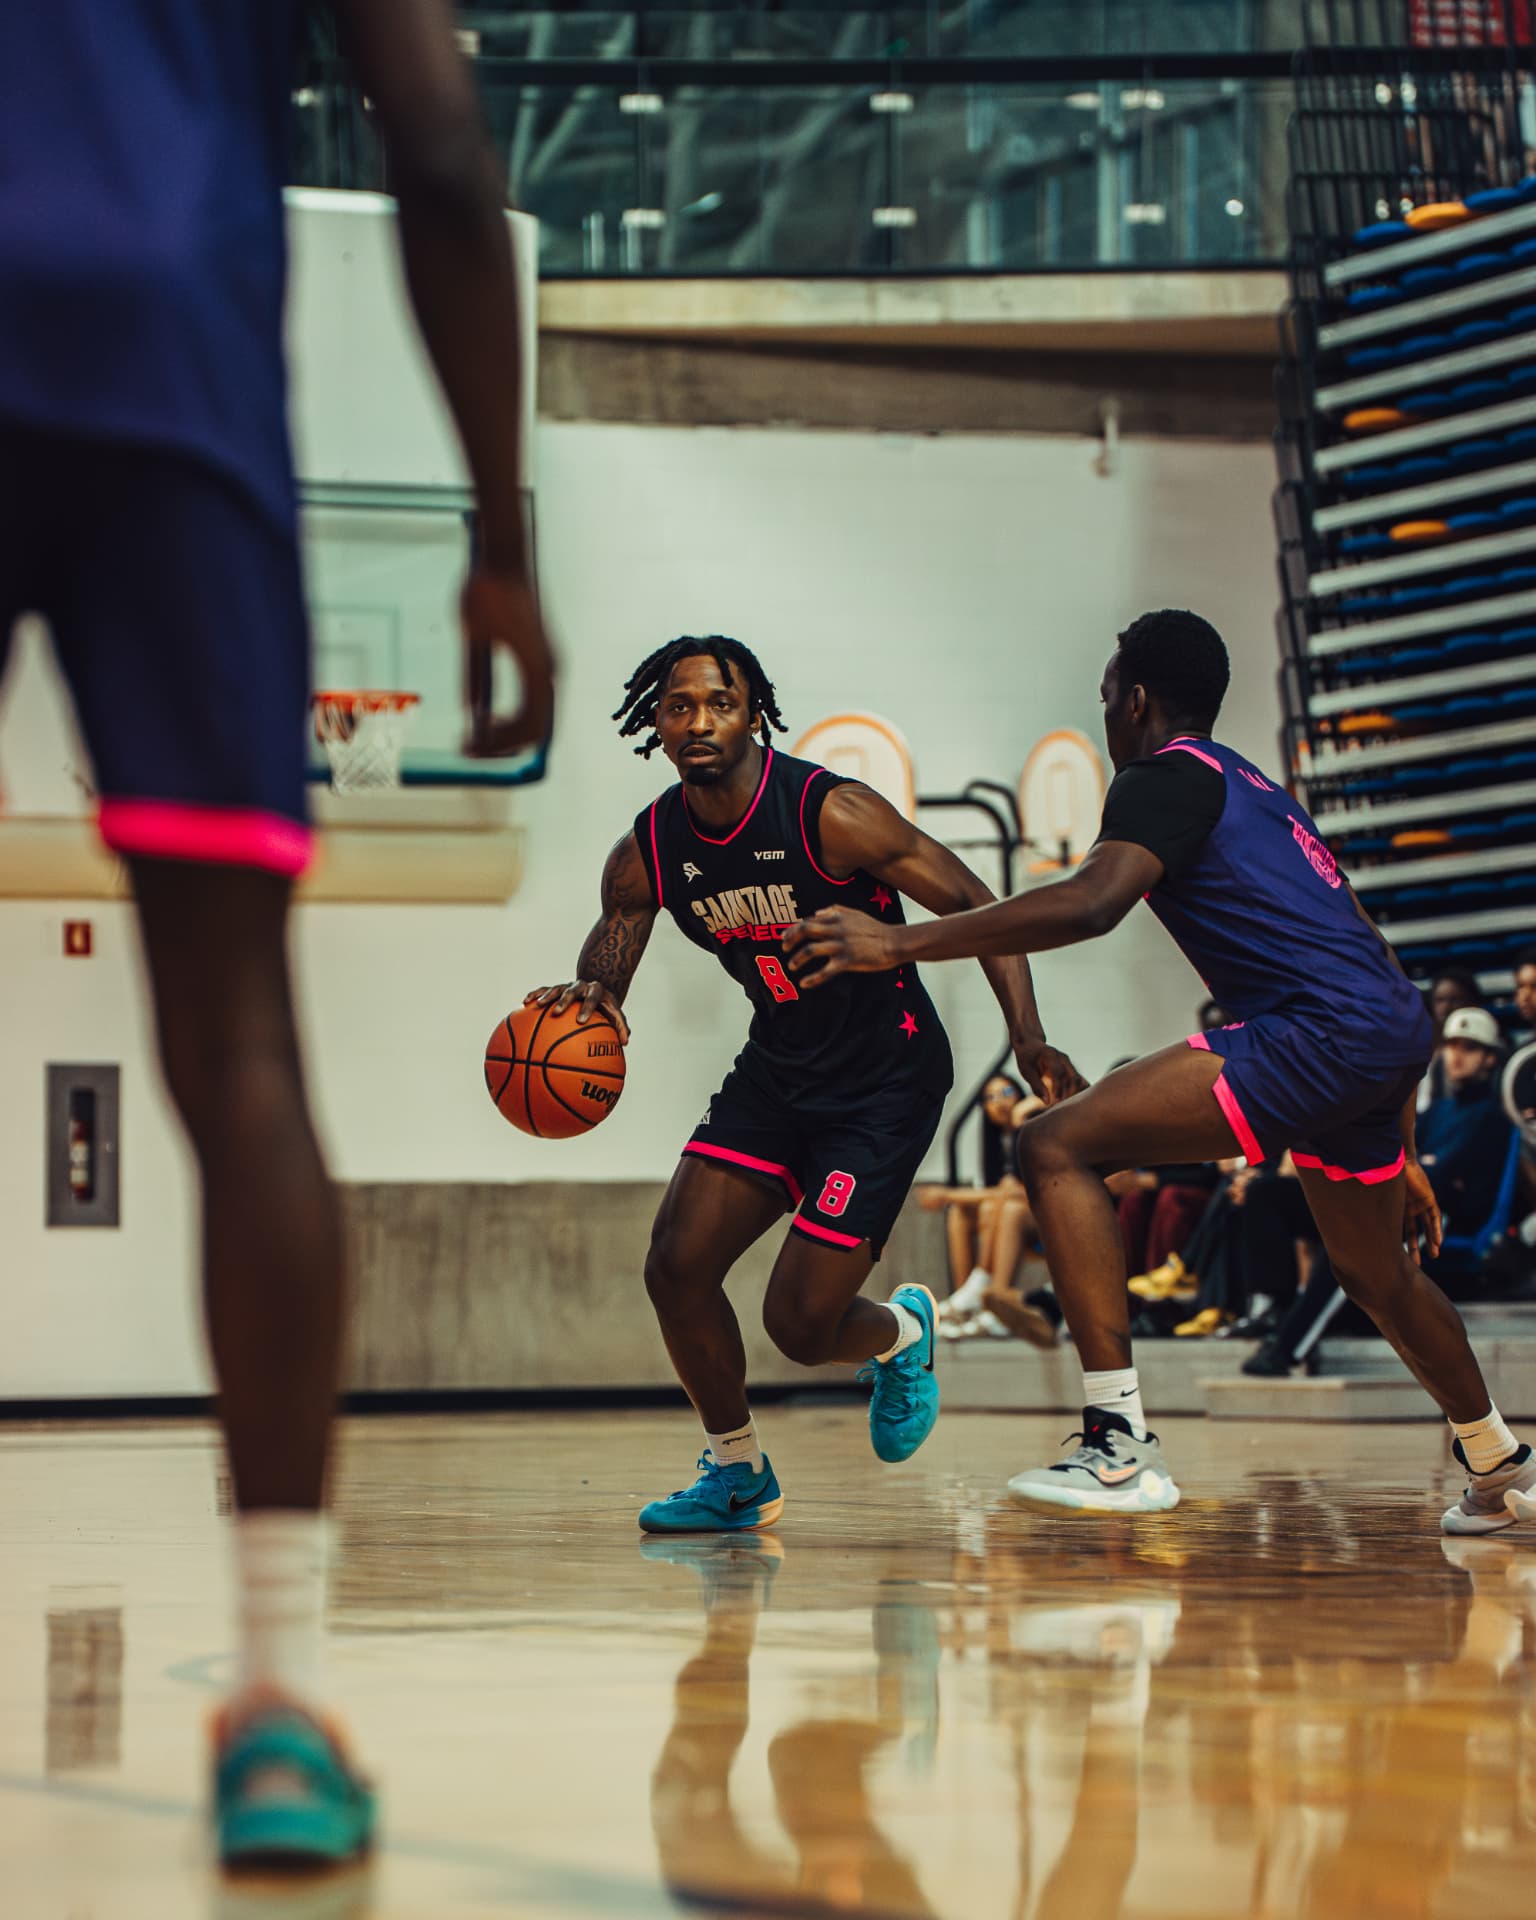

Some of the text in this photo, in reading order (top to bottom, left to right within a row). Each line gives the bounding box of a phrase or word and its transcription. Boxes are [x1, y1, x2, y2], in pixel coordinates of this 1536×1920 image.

[754, 850, 785, 861] YGM
[755, 955, 799, 1002] 8
[817, 1170, 856, 1217] 8
